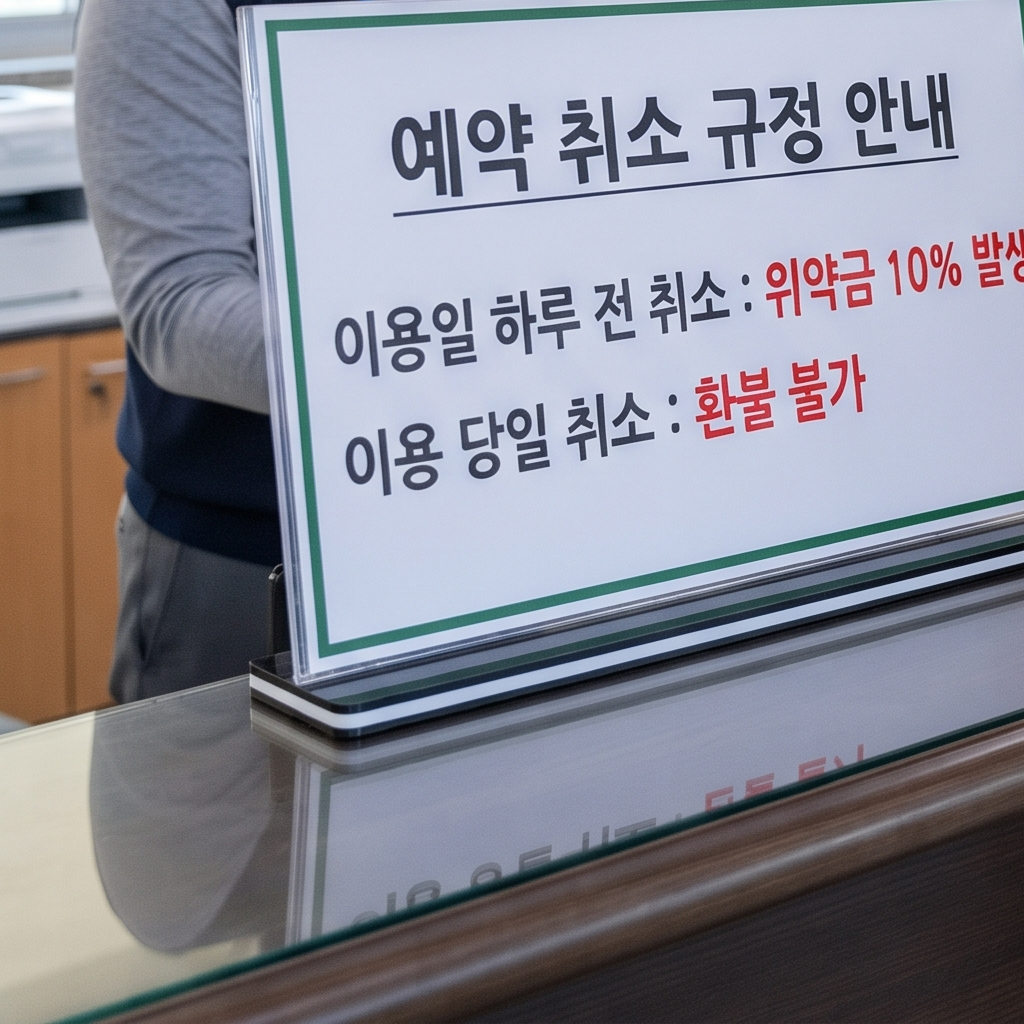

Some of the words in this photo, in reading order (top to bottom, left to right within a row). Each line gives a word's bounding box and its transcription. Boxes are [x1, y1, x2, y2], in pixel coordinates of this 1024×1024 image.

[392, 104, 534, 197] 예약
[559, 96, 690, 183] 취소
[706, 81, 824, 170] 규정
[846, 72, 955, 158] 안내
[335, 297, 478, 378] 이용일
[490, 286, 581, 356] 하루
[594, 277, 637, 343] 전
[649, 270, 731, 335] 취소
[766, 249, 876, 319] 위약금
[887, 241, 963, 296] 10%
[345, 422, 444, 497] 이용
[460, 402, 551, 480] 당일
[566, 391, 655, 462] 취소
[694, 367, 777, 440] 환불
[787, 353, 867, 424] 불가
